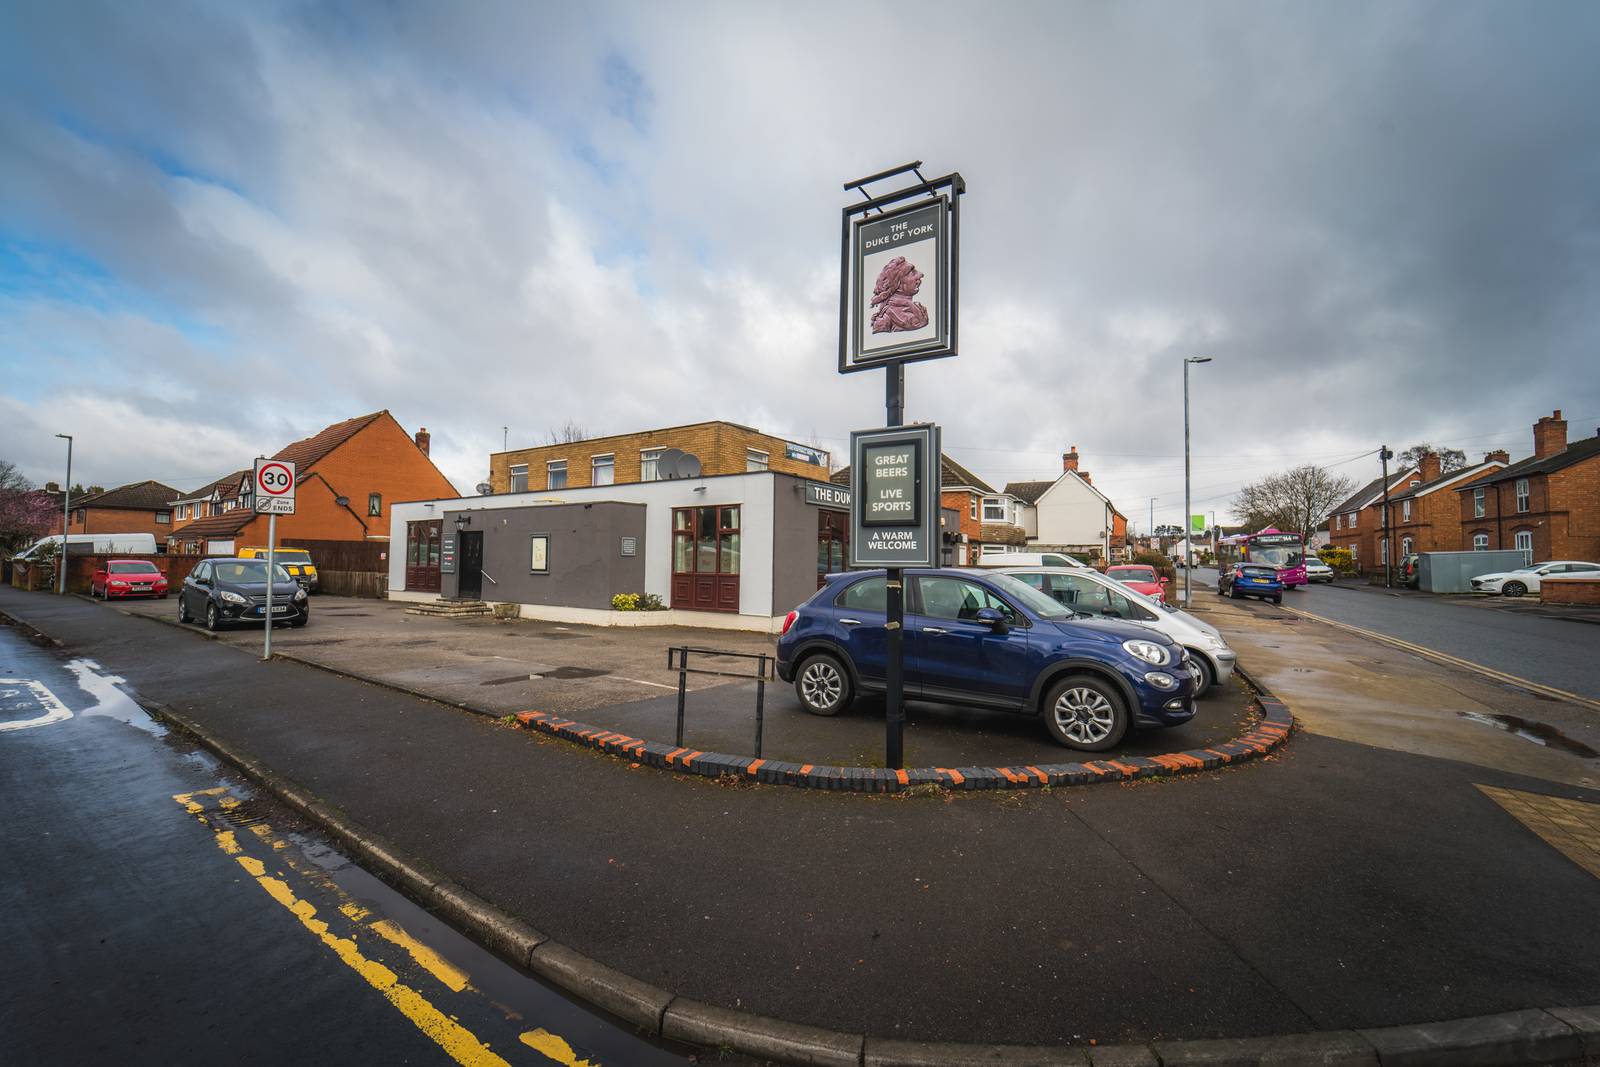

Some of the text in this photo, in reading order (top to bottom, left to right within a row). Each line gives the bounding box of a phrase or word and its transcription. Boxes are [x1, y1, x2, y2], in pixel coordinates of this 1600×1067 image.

[890, 222, 907, 232] THE
[866, 224, 933, 248] DUKE OF YORK
[875, 454, 909, 465] GREAT
[875, 467, 908, 478] BEERS
[265, 473, 288, 486] 30
[814, 487, 832, 502] THE
[880, 489, 903, 499] LIVE
[872, 502, 911, 511] SPORTS
[872, 532, 913, 540] A WARM
[868, 541, 917, 550] WELCOME
